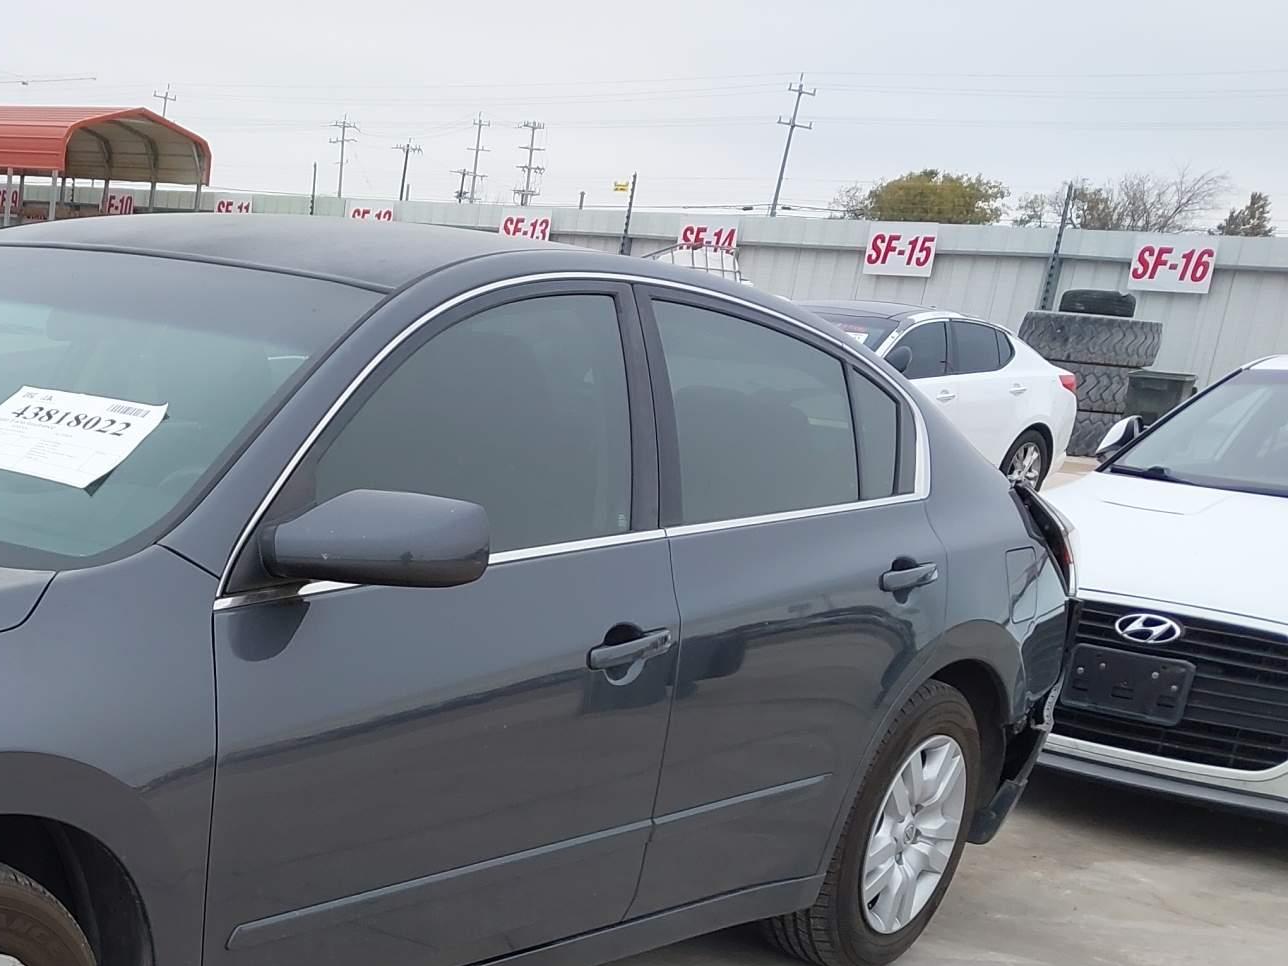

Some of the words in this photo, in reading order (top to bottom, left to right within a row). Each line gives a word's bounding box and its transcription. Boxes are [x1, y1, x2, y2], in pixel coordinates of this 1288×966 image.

[503, 216, 550, 240] SF-13
[679, 225, 737, 255] SF-14
[865, 233, 936, 267] SF-15
[1130, 244, 1215, 283] SF-16
[11, 404, 132, 437] 43818022
